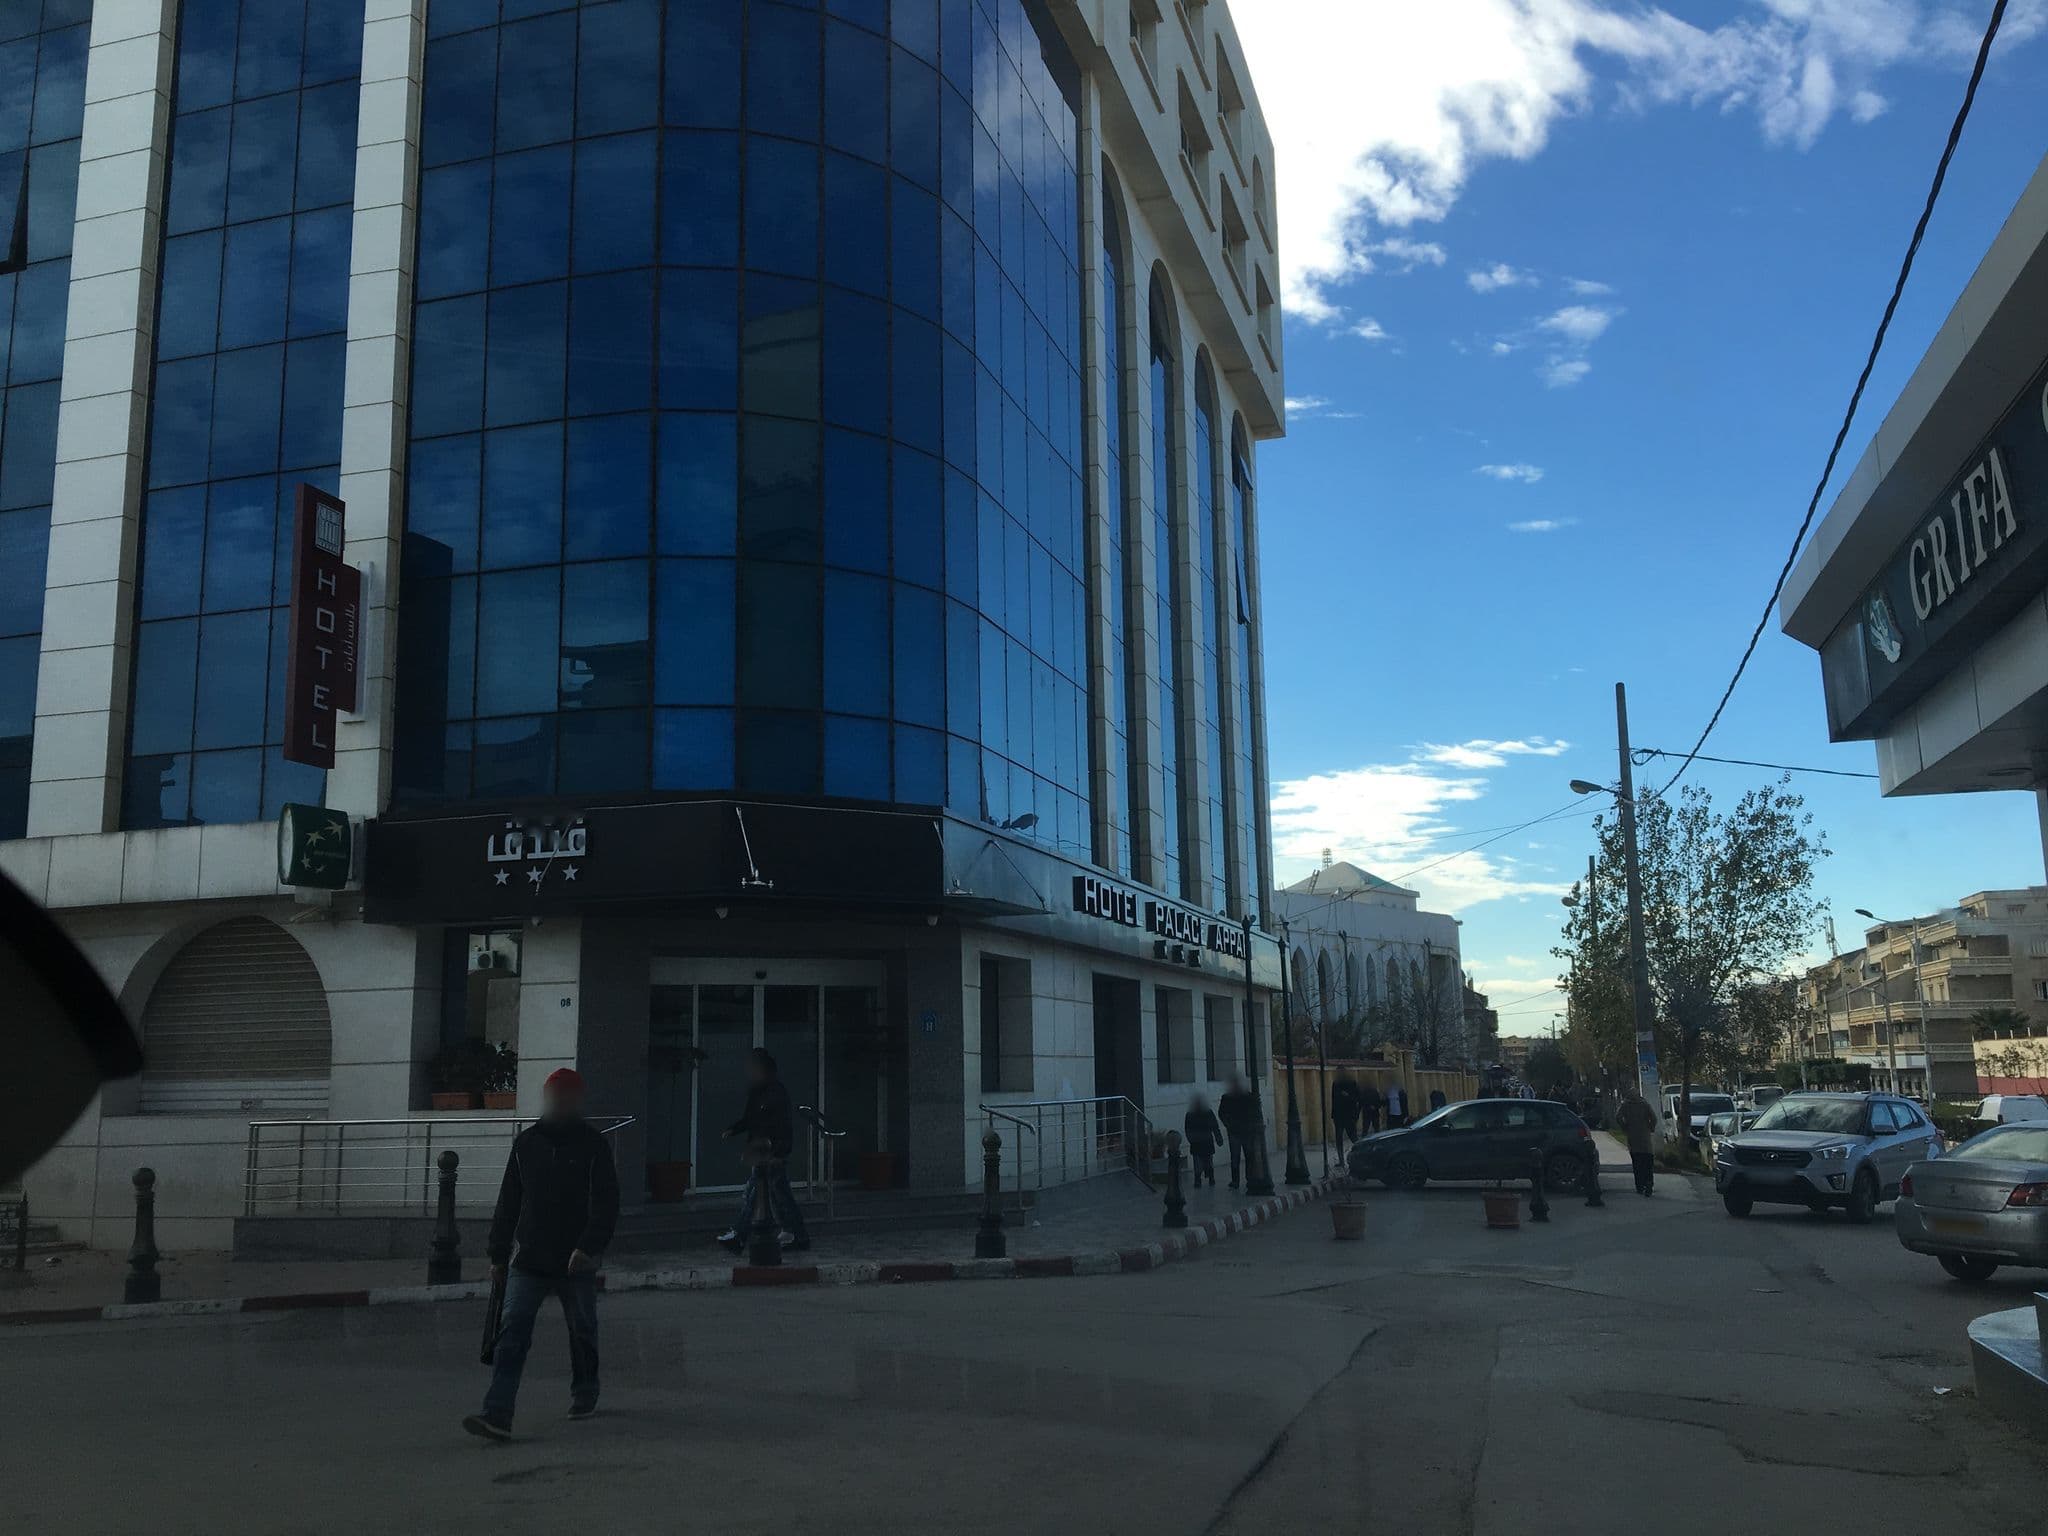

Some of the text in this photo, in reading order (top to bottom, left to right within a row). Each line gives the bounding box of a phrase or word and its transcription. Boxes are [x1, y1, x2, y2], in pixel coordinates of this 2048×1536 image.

[1909, 448, 2017, 622] GRIFA
[311, 567, 337, 750] HOTEL
[1081, 876, 1144, 928] HOTEL
